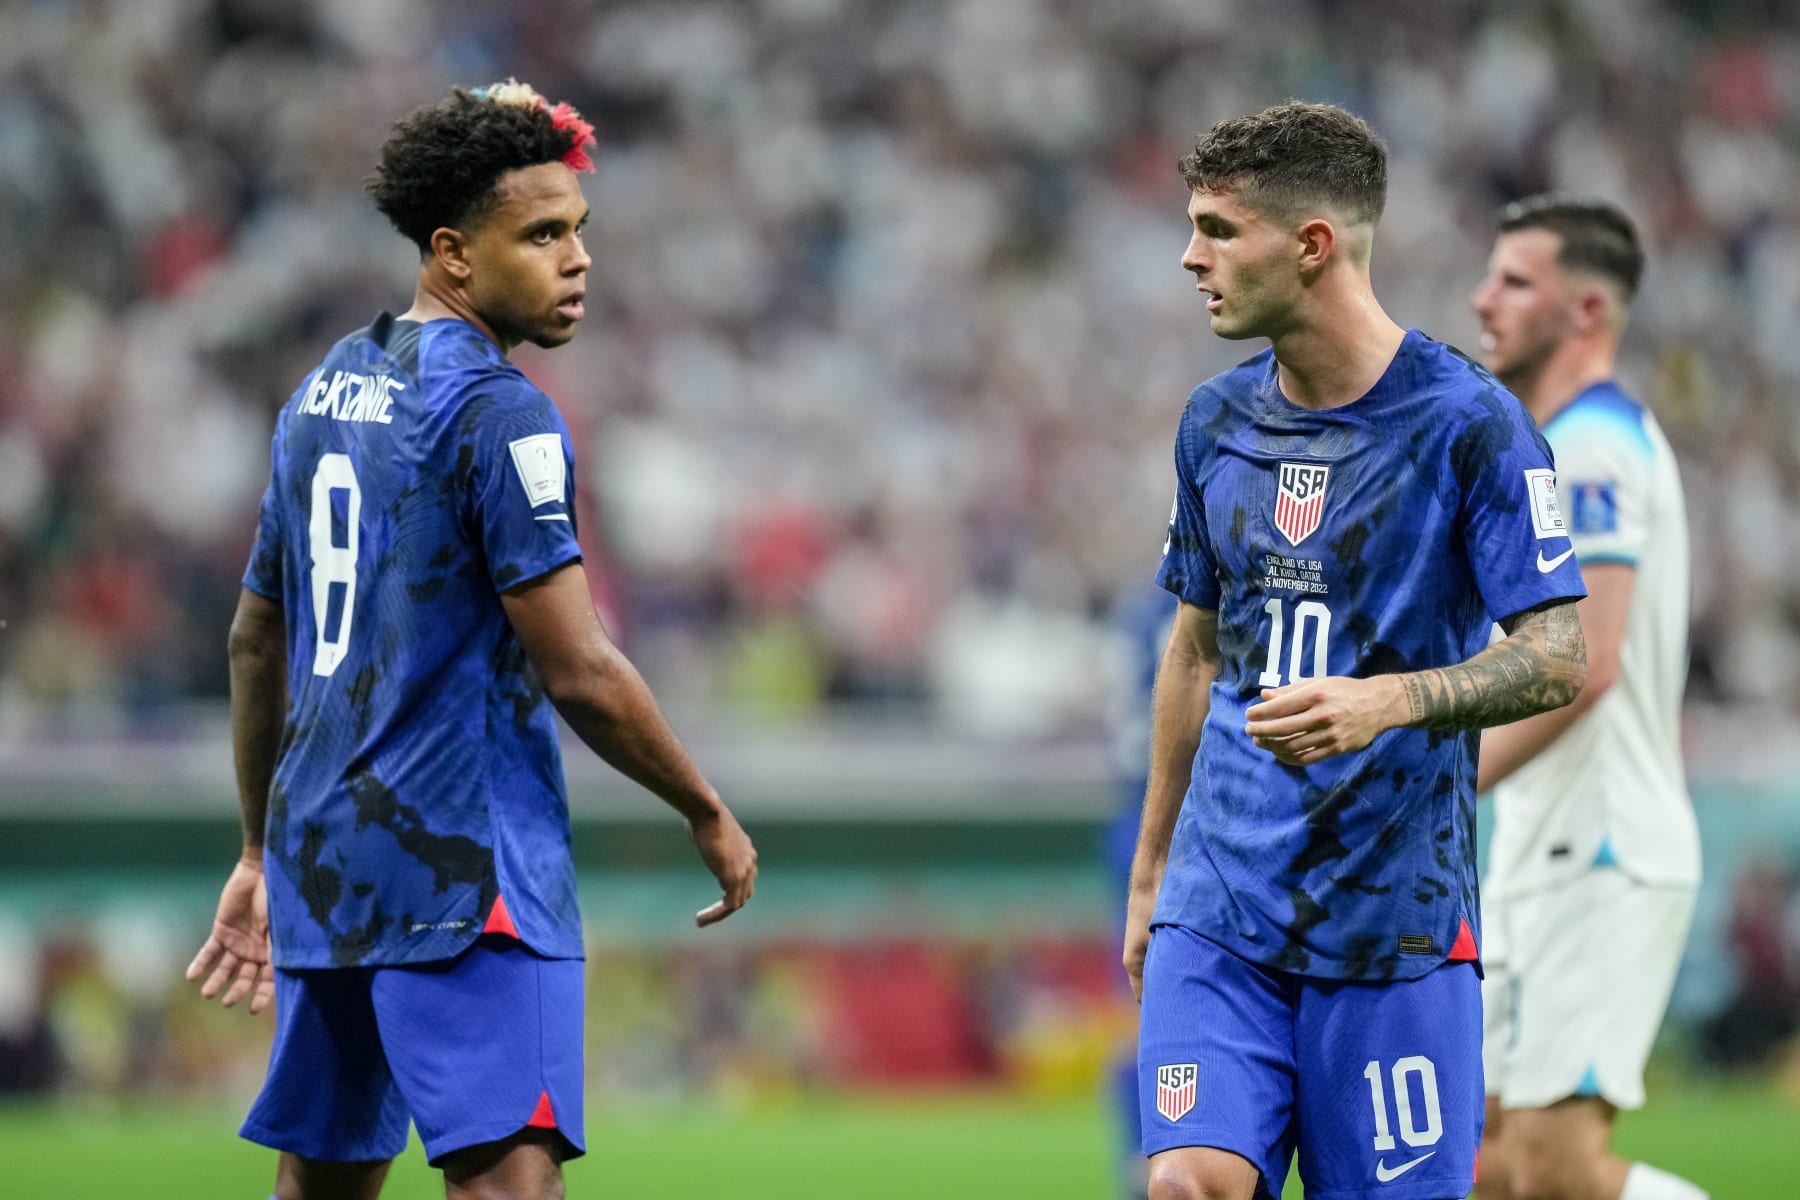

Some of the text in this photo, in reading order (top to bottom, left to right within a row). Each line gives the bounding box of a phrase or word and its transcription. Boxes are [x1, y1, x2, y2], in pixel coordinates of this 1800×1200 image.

[1282, 467, 1326, 500] USA
[309, 453, 362, 677] 8
[1265, 554, 1322, 571] ENGLAND VS. USA
[1268, 565, 1279, 576] AL
[1300, 570, 1321, 582] QATAR
[1272, 577, 1309, 591] NOVEMBER
[1310, 582, 1328, 593] 2022
[1258, 598, 1332, 688] 10
[1159, 1066, 1195, 1089] USA
[1363, 1055, 1444, 1151] 10
